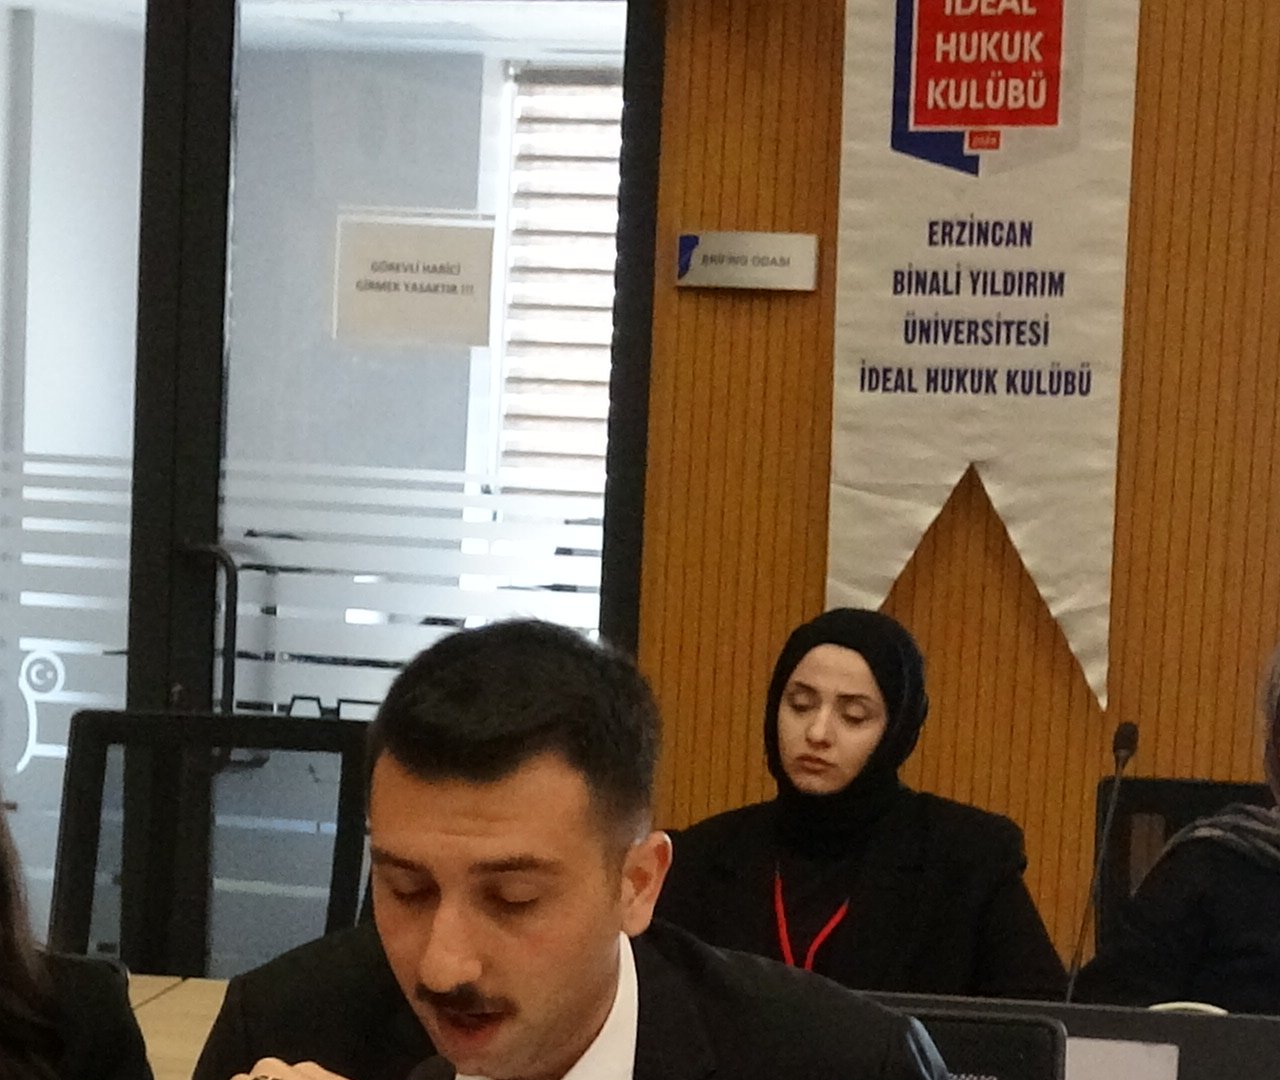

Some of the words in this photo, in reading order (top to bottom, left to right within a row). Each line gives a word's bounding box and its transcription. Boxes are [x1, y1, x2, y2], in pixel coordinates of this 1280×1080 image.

[935, 31, 1044, 63] HUKUK
[927, 70, 1047, 110] KULÜBÜ
[927, 213, 1034, 248] ERZİNCAN
[892, 262, 962, 297] BİNALİ
[969, 270, 1066, 298] YILDIRIM
[903, 311, 1050, 347] ÜNİVERSİTESİ
[859, 359, 918, 394] İDEAL
[925, 367, 998, 395] HUKUK
[1006, 361, 1092, 397] KULÜBÜ
